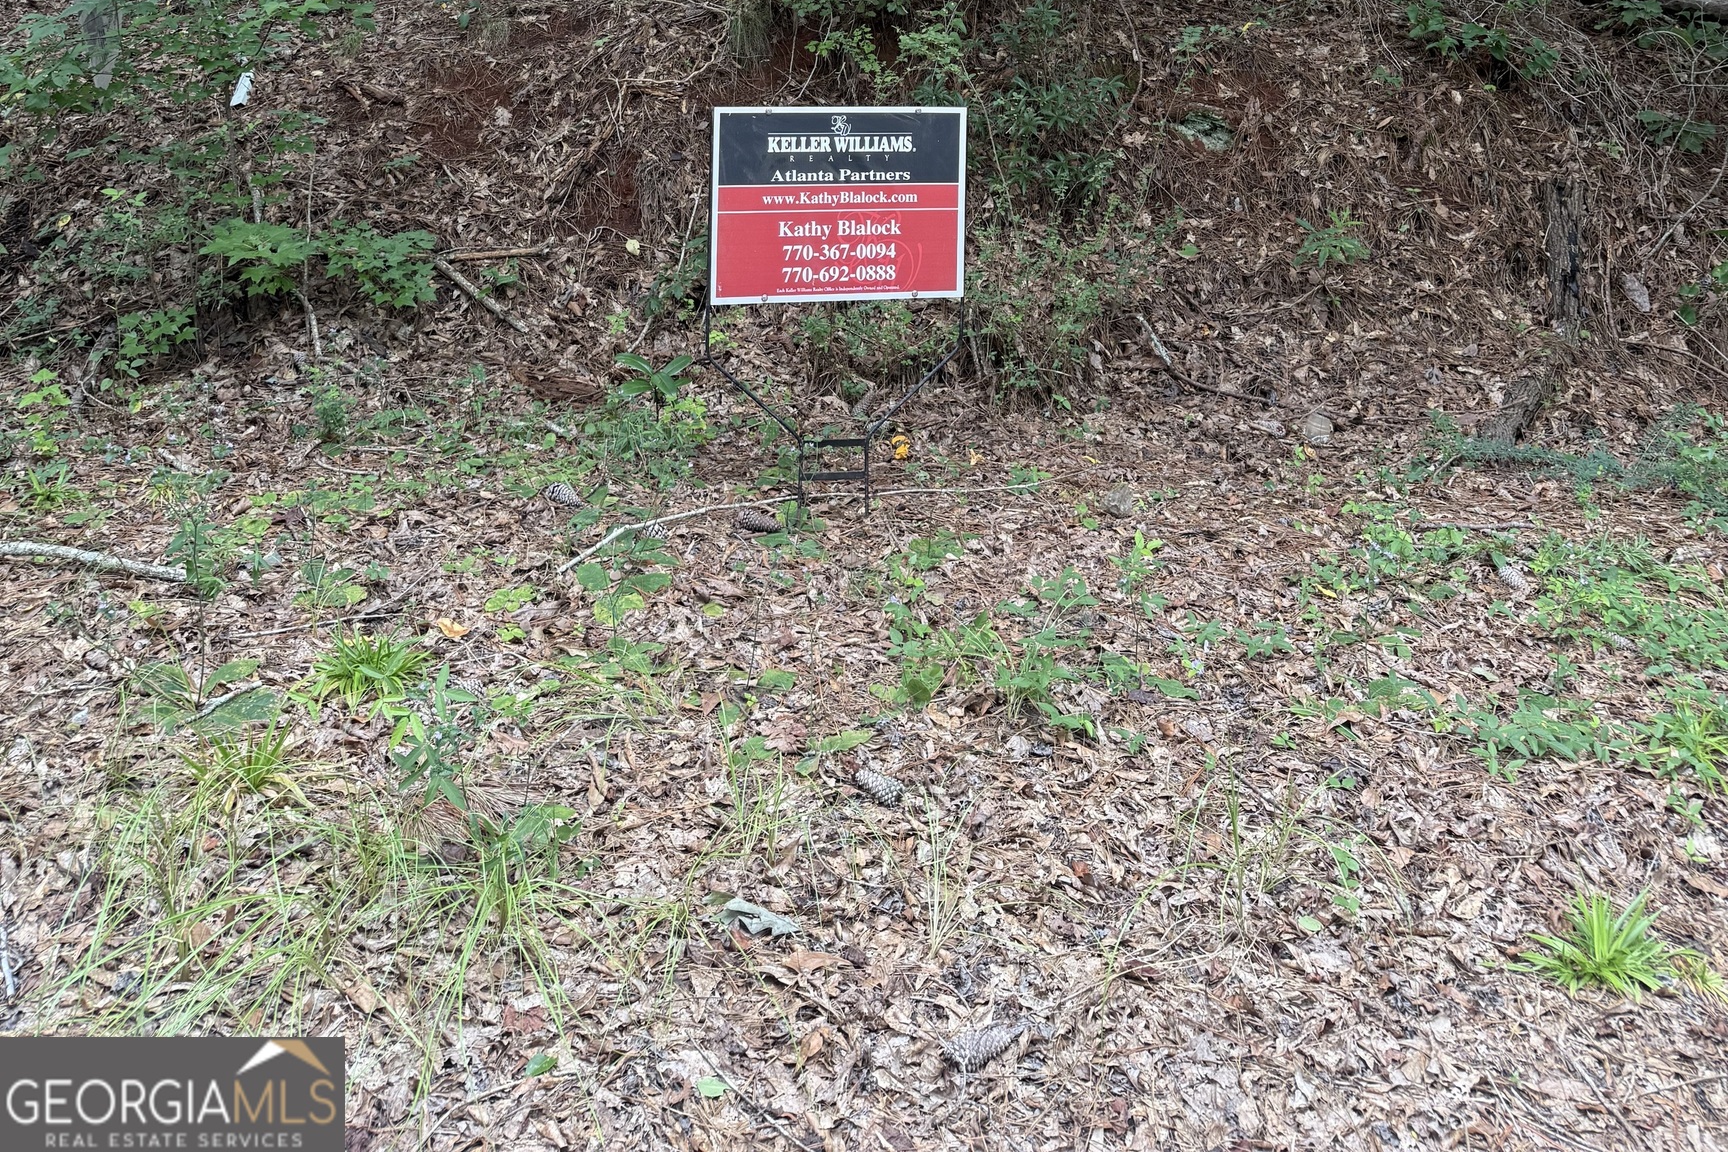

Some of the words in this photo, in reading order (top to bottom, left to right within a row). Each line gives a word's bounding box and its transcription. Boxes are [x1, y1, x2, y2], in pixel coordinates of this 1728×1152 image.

[767, 136, 832, 153] KELLER
[789, 154, 890, 163] REALTY
[770, 169, 834, 182] Atlanta
[838, 168, 911, 181] Partners
[762, 191, 918, 207] www.KathyBlalock.com
[778, 220, 833, 240] Kathy
[837, 219, 902, 237] Blalock
[782, 243, 896, 261] 770-367-0094
[782, 265, 896, 283] 770-692-0888
